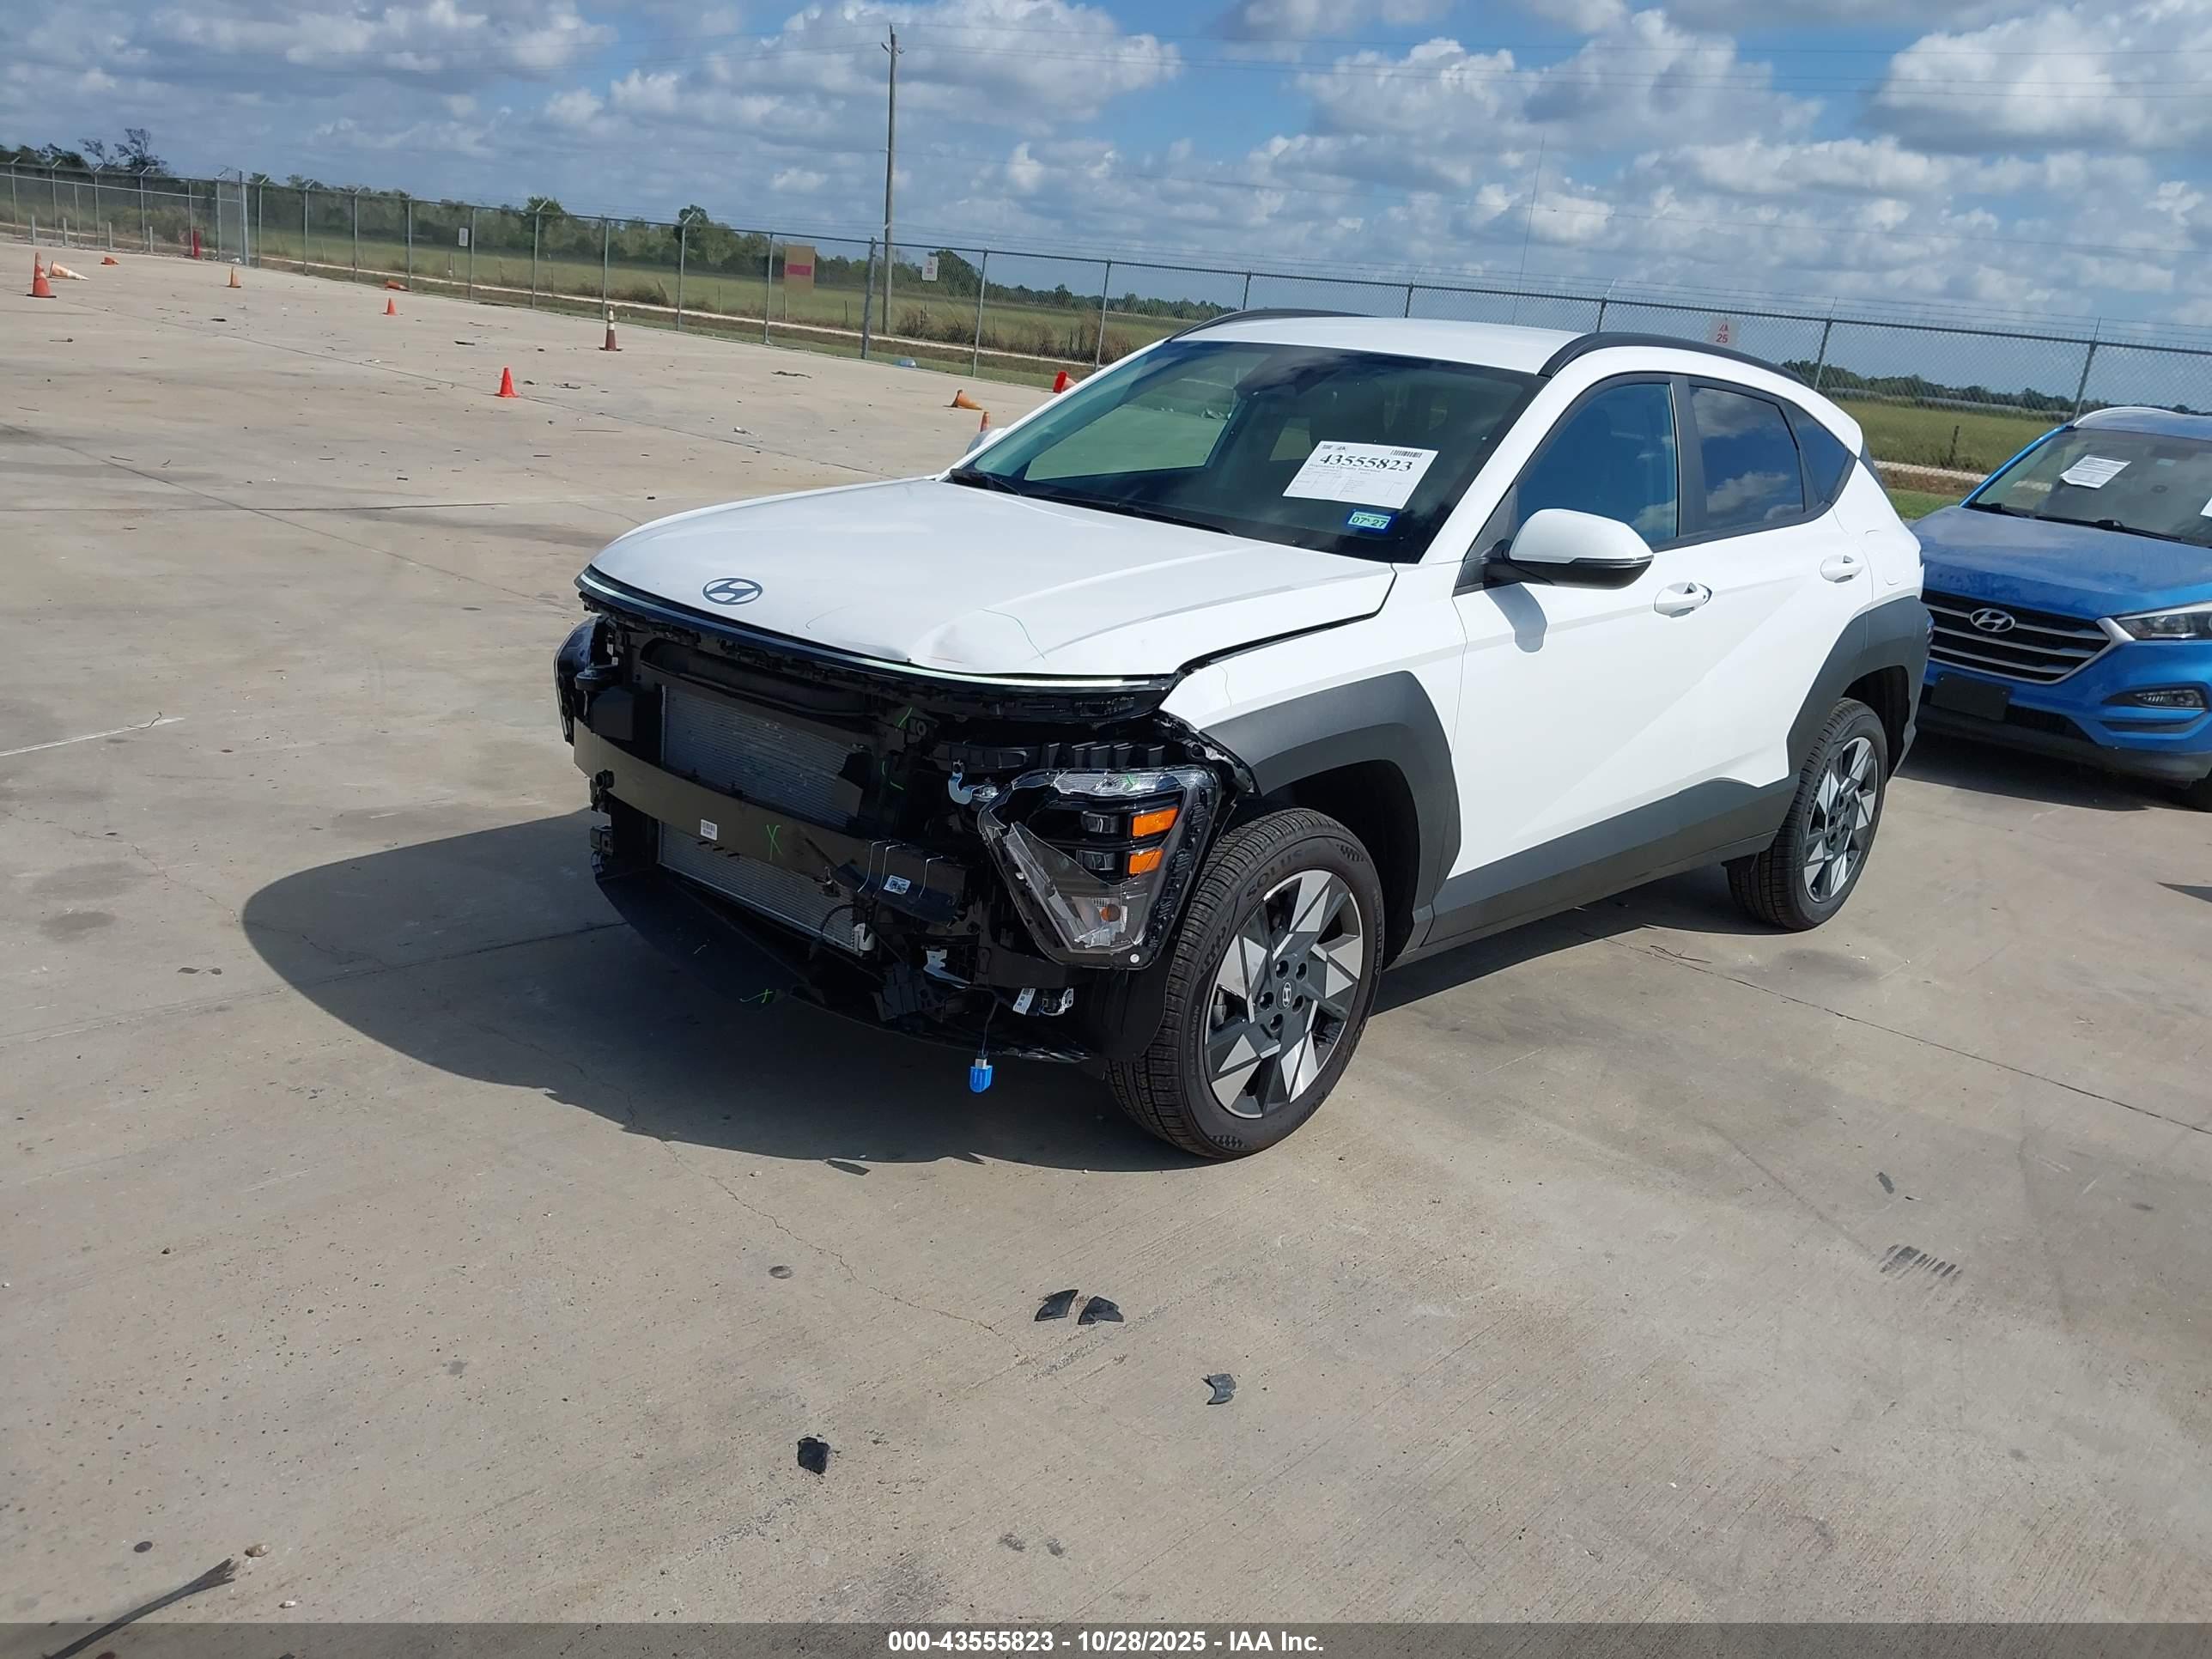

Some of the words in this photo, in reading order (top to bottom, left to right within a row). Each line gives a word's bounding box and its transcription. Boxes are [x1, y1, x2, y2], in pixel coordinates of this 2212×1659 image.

[1717, 333, 1728, 343] 25
[1320, 454, 1413, 472] 43555823
[1807, 757, 1831, 815] KUMHO
[1246, 849, 1304, 901] SOLUS
